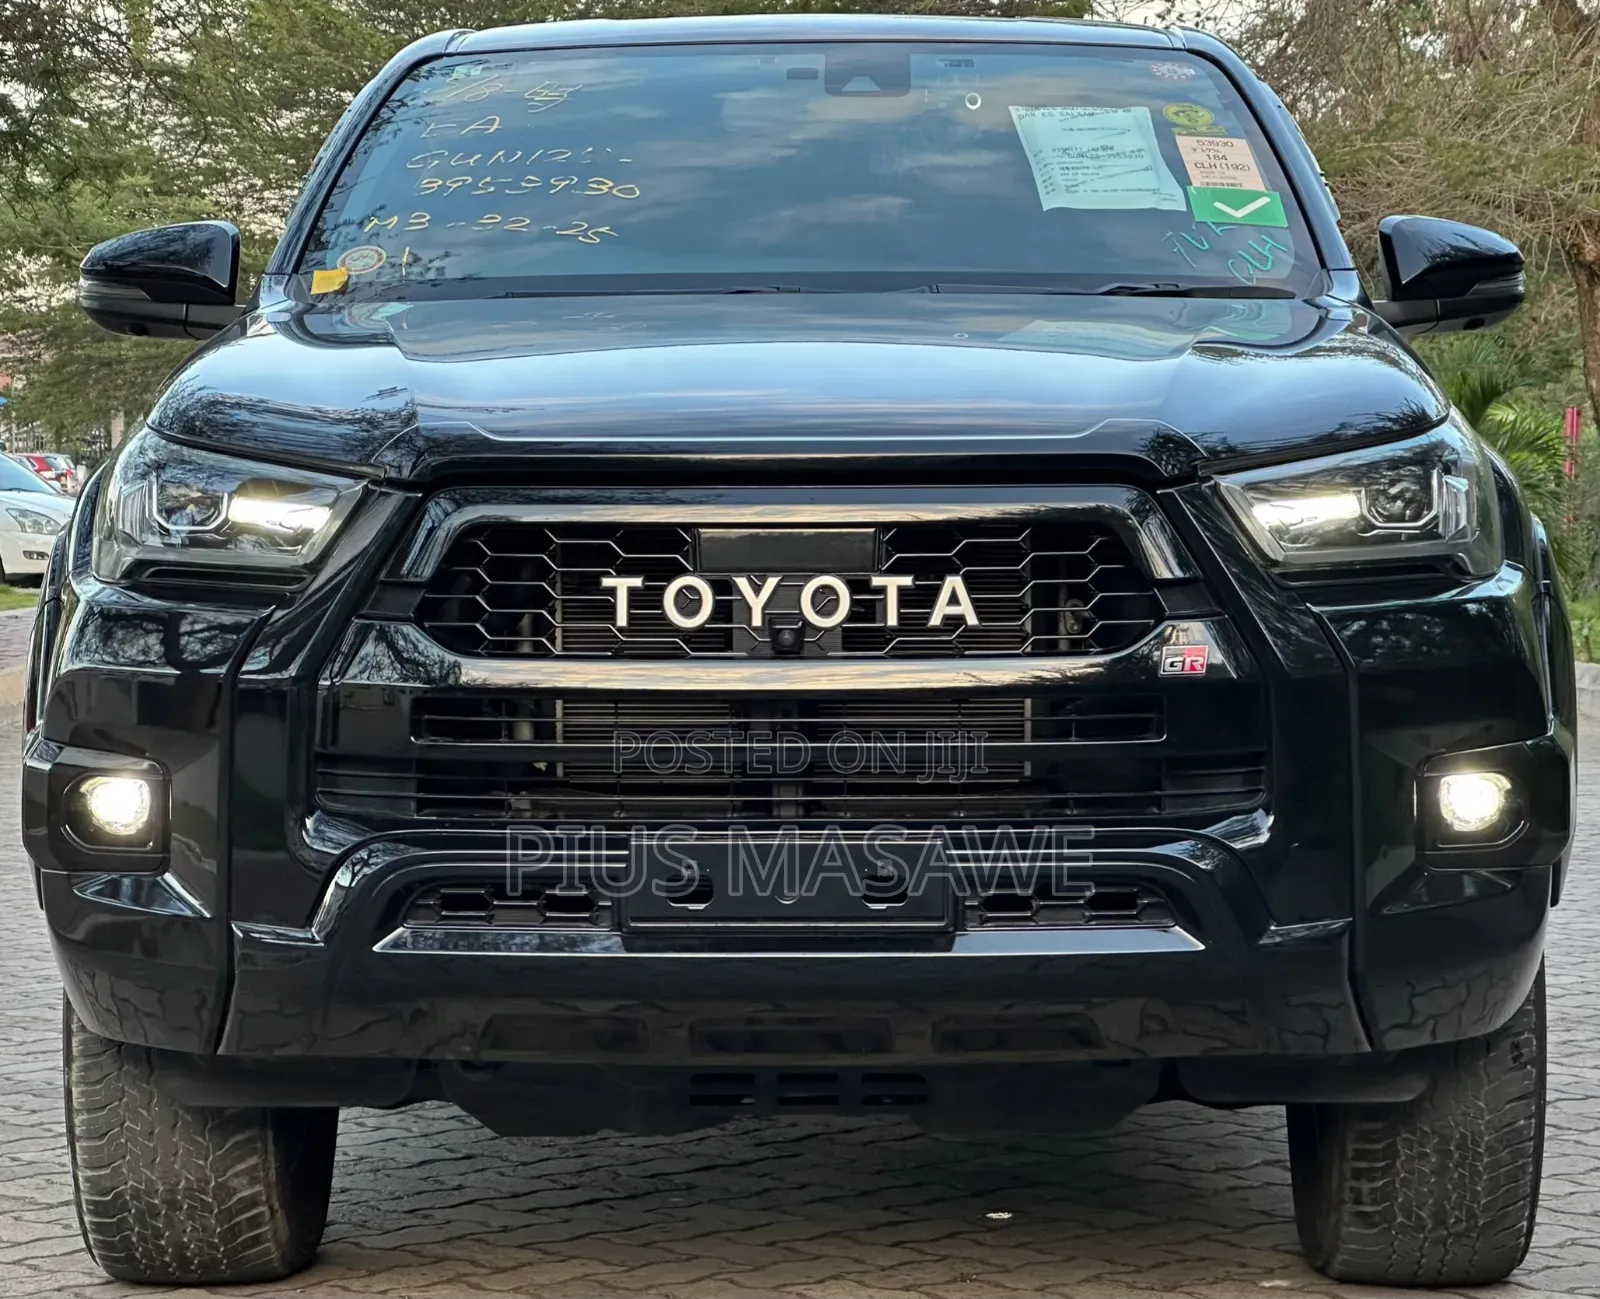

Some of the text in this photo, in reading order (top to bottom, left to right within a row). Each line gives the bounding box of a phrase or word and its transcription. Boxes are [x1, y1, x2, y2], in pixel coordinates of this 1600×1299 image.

[1206, 153, 1229, 161] 184
[600, 574, 981, 629] TOYOTA
[1164, 656, 1205, 672] GR
